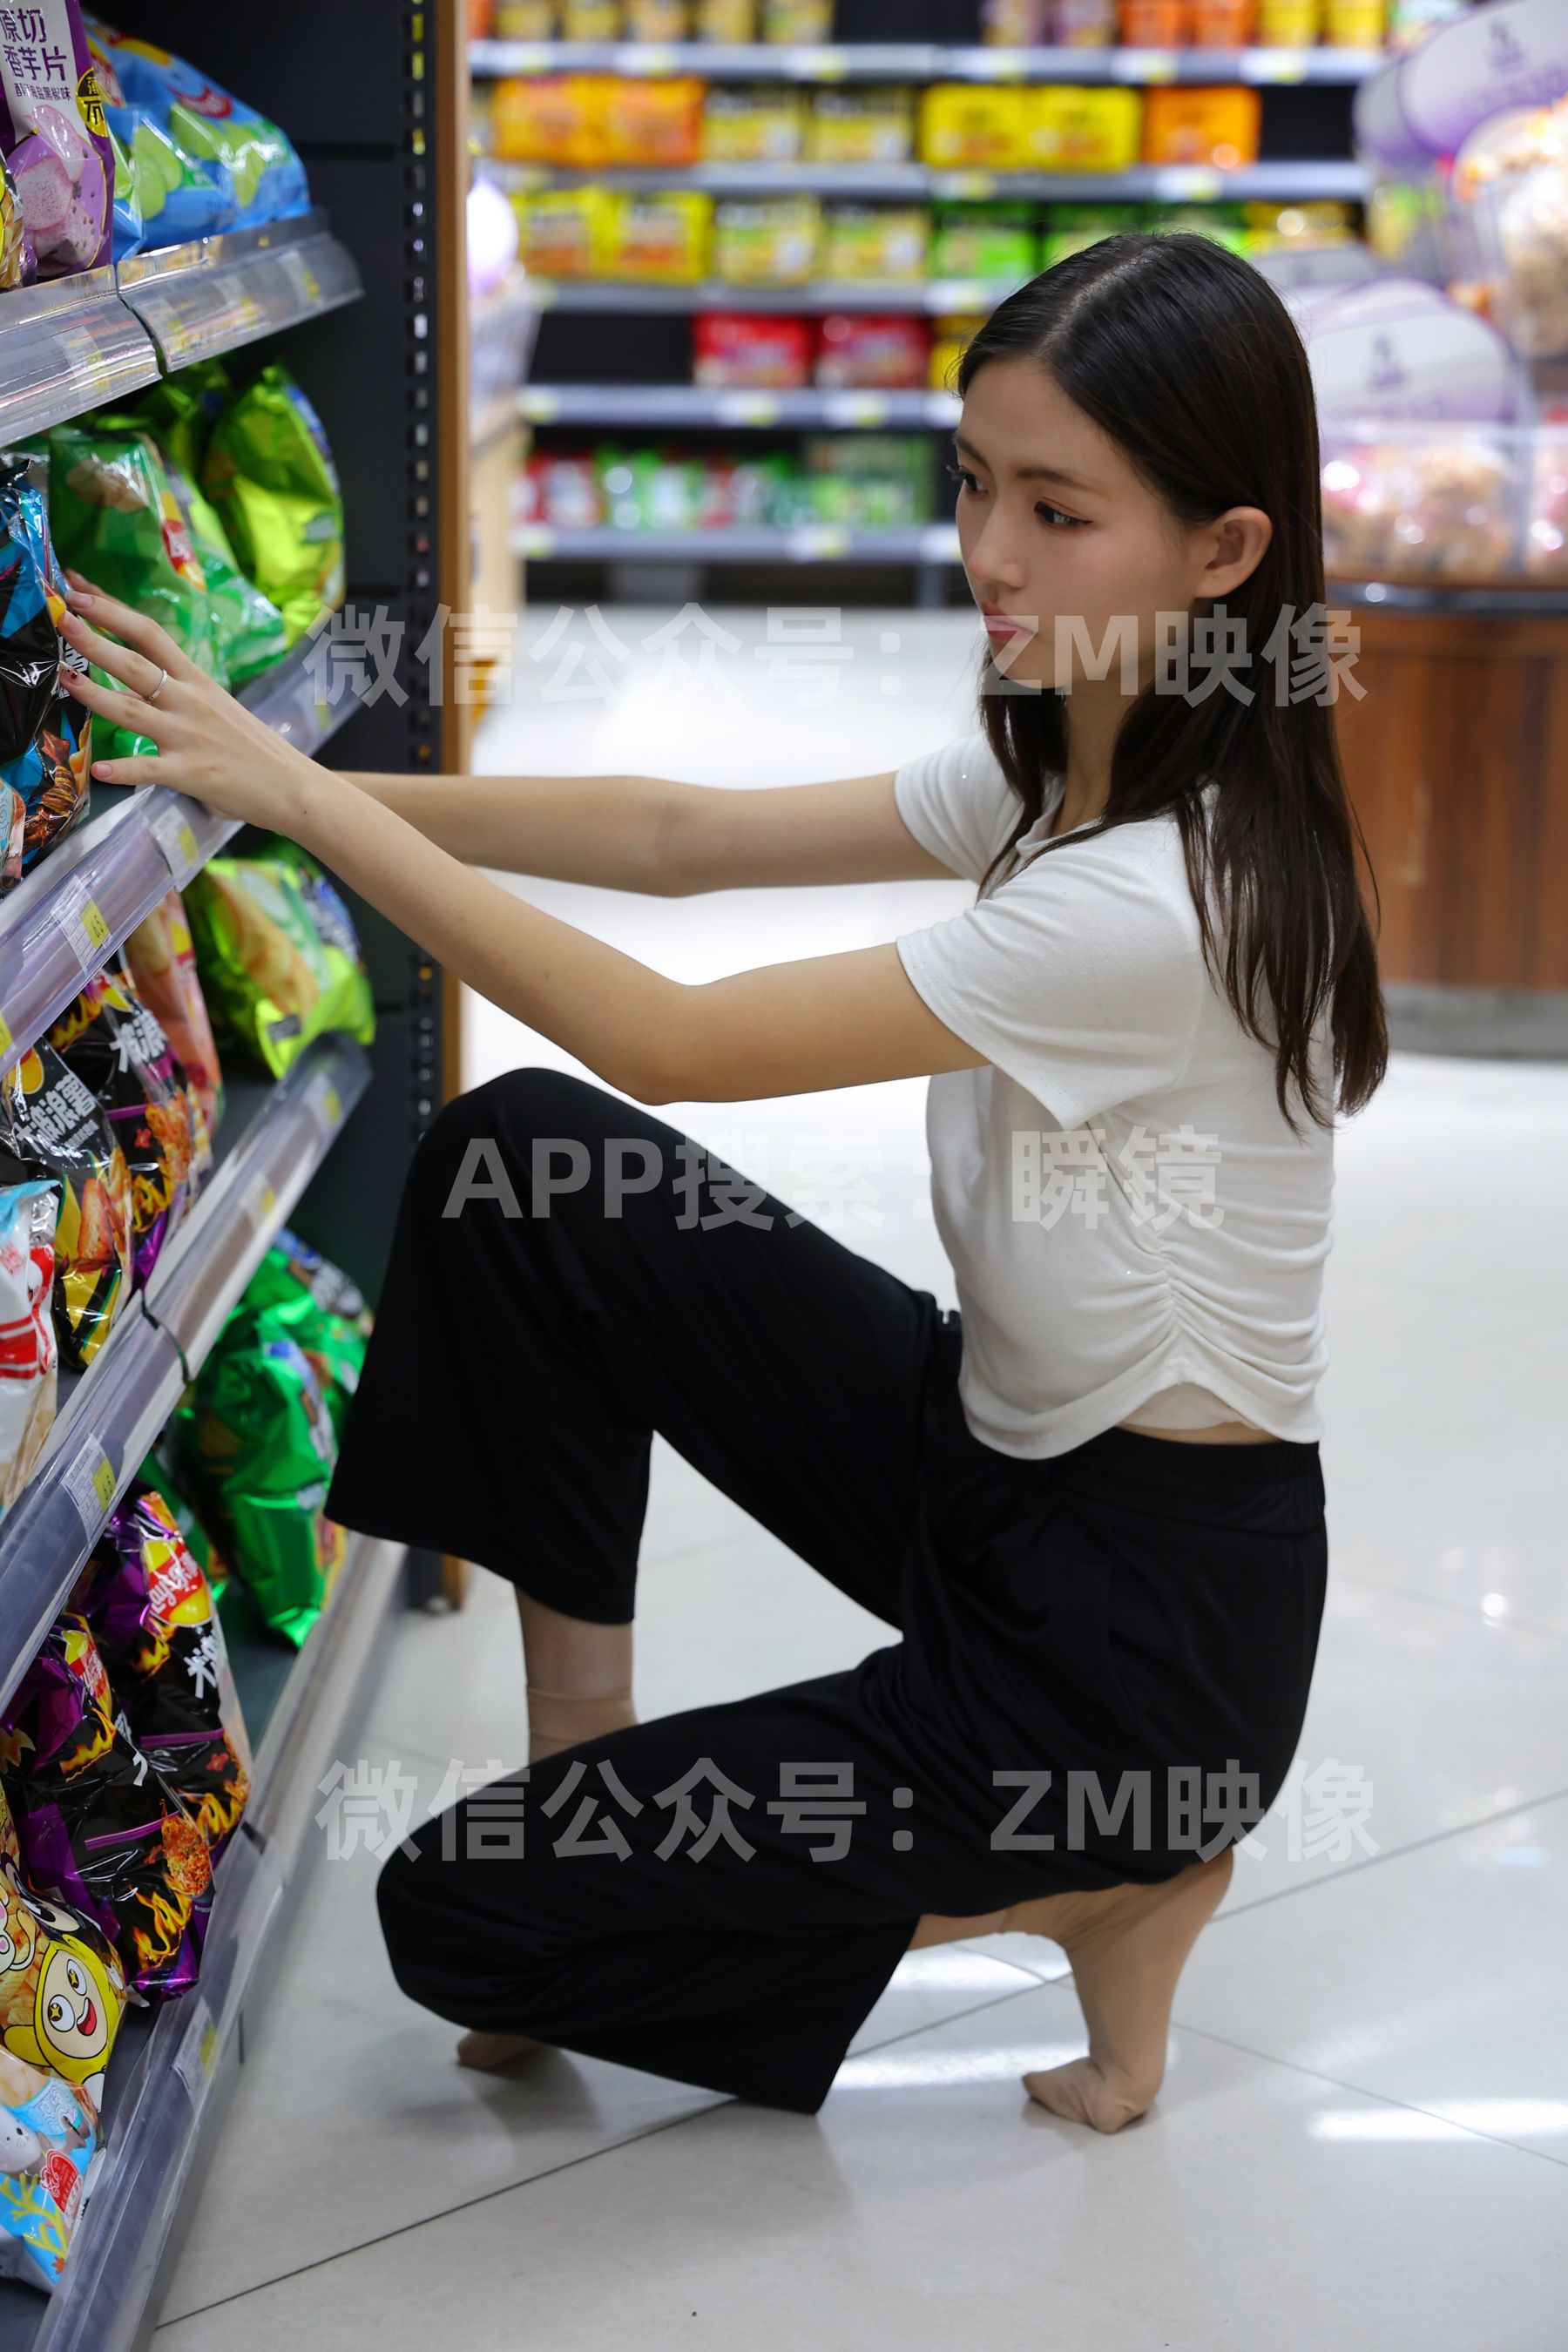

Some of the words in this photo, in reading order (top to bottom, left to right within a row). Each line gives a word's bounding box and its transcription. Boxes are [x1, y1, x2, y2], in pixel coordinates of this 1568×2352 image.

[0, 8, 47, 43] 原切
[3, 44, 67, 81] 香芋片
